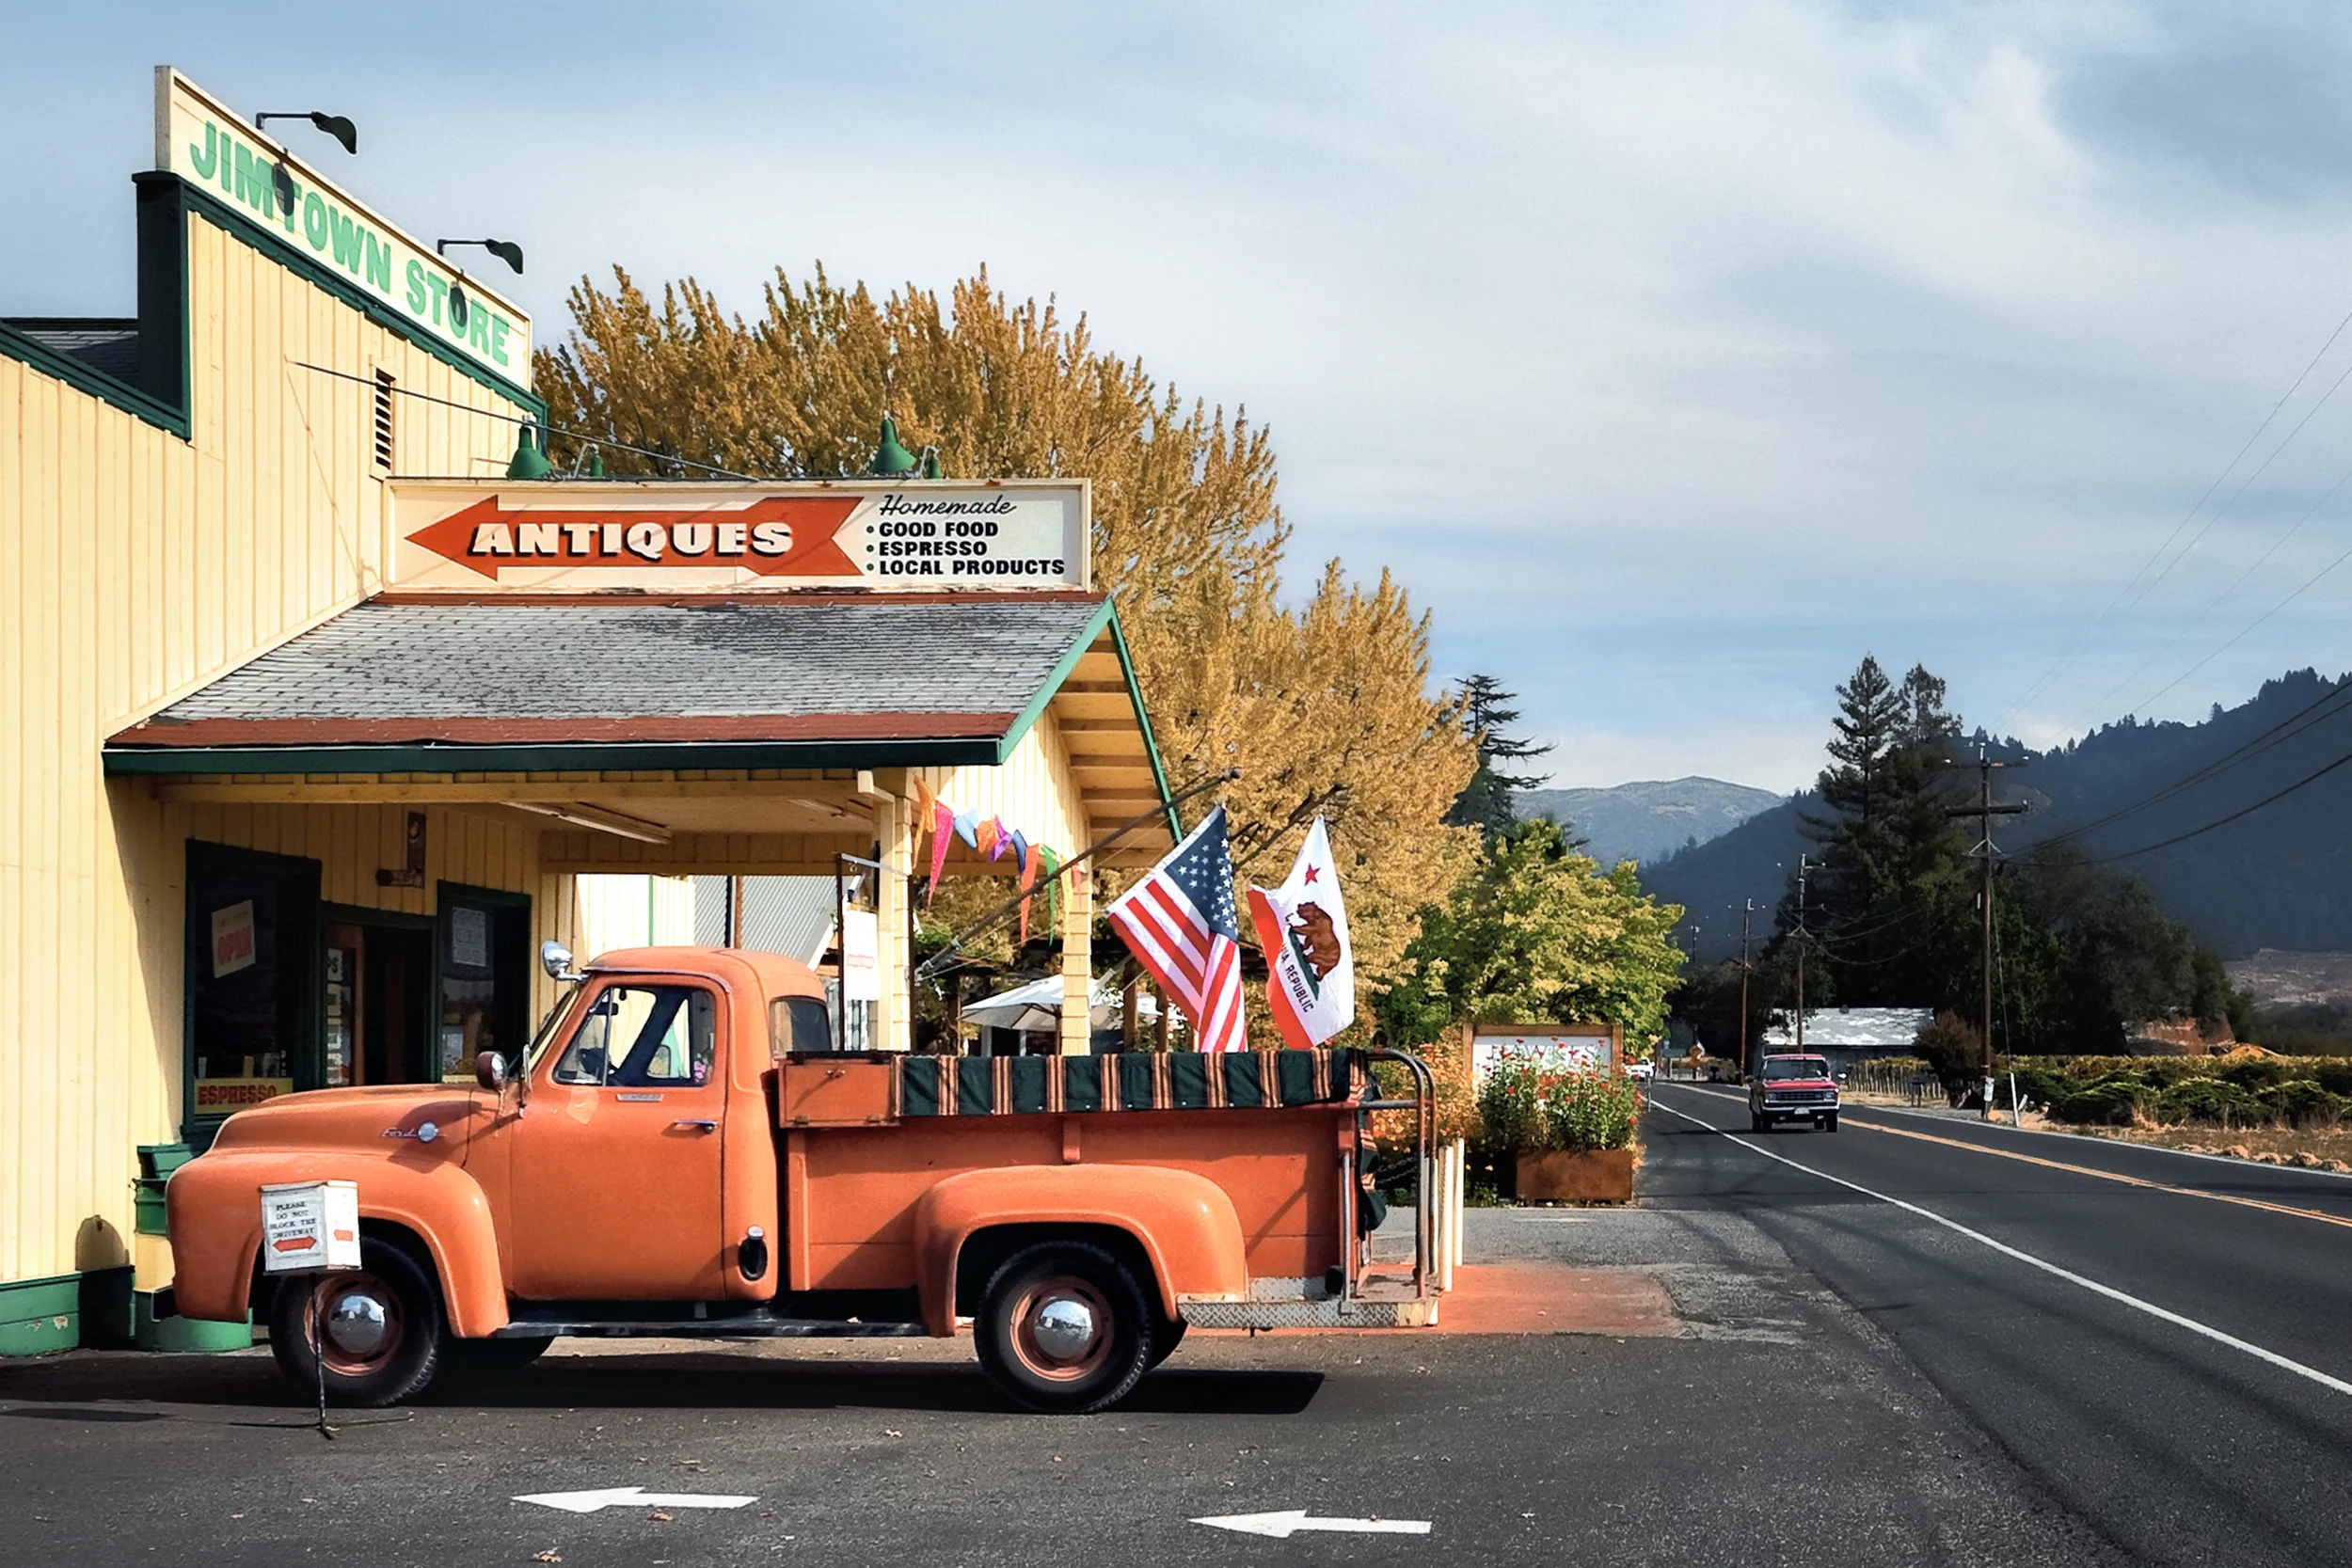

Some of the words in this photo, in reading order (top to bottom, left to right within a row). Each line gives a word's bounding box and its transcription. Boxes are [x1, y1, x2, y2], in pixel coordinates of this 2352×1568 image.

[189, 120, 390, 294] JIMTOWN
[406, 259, 509, 368] STORE
[879, 495, 1017, 515] Homemade
[880, 522, 936, 537] GOOD
[945, 522, 998, 537] FOOD
[469, 522, 793, 561] ANTIQUES
[880, 541, 988, 556] ESPRESSO
[880, 560, 944, 575] LOCAL
[952, 560, 1065, 575] PRODUCTS
[1285, 964, 1314, 1012] REPUBLIC
[198, 1085, 277, 1105] ESPRESSO
[276, 1201, 307, 1211] PLEASE
[270, 1221, 295, 1229] BLOCK
[273, 1227, 314, 1239] DRIVEWAY
